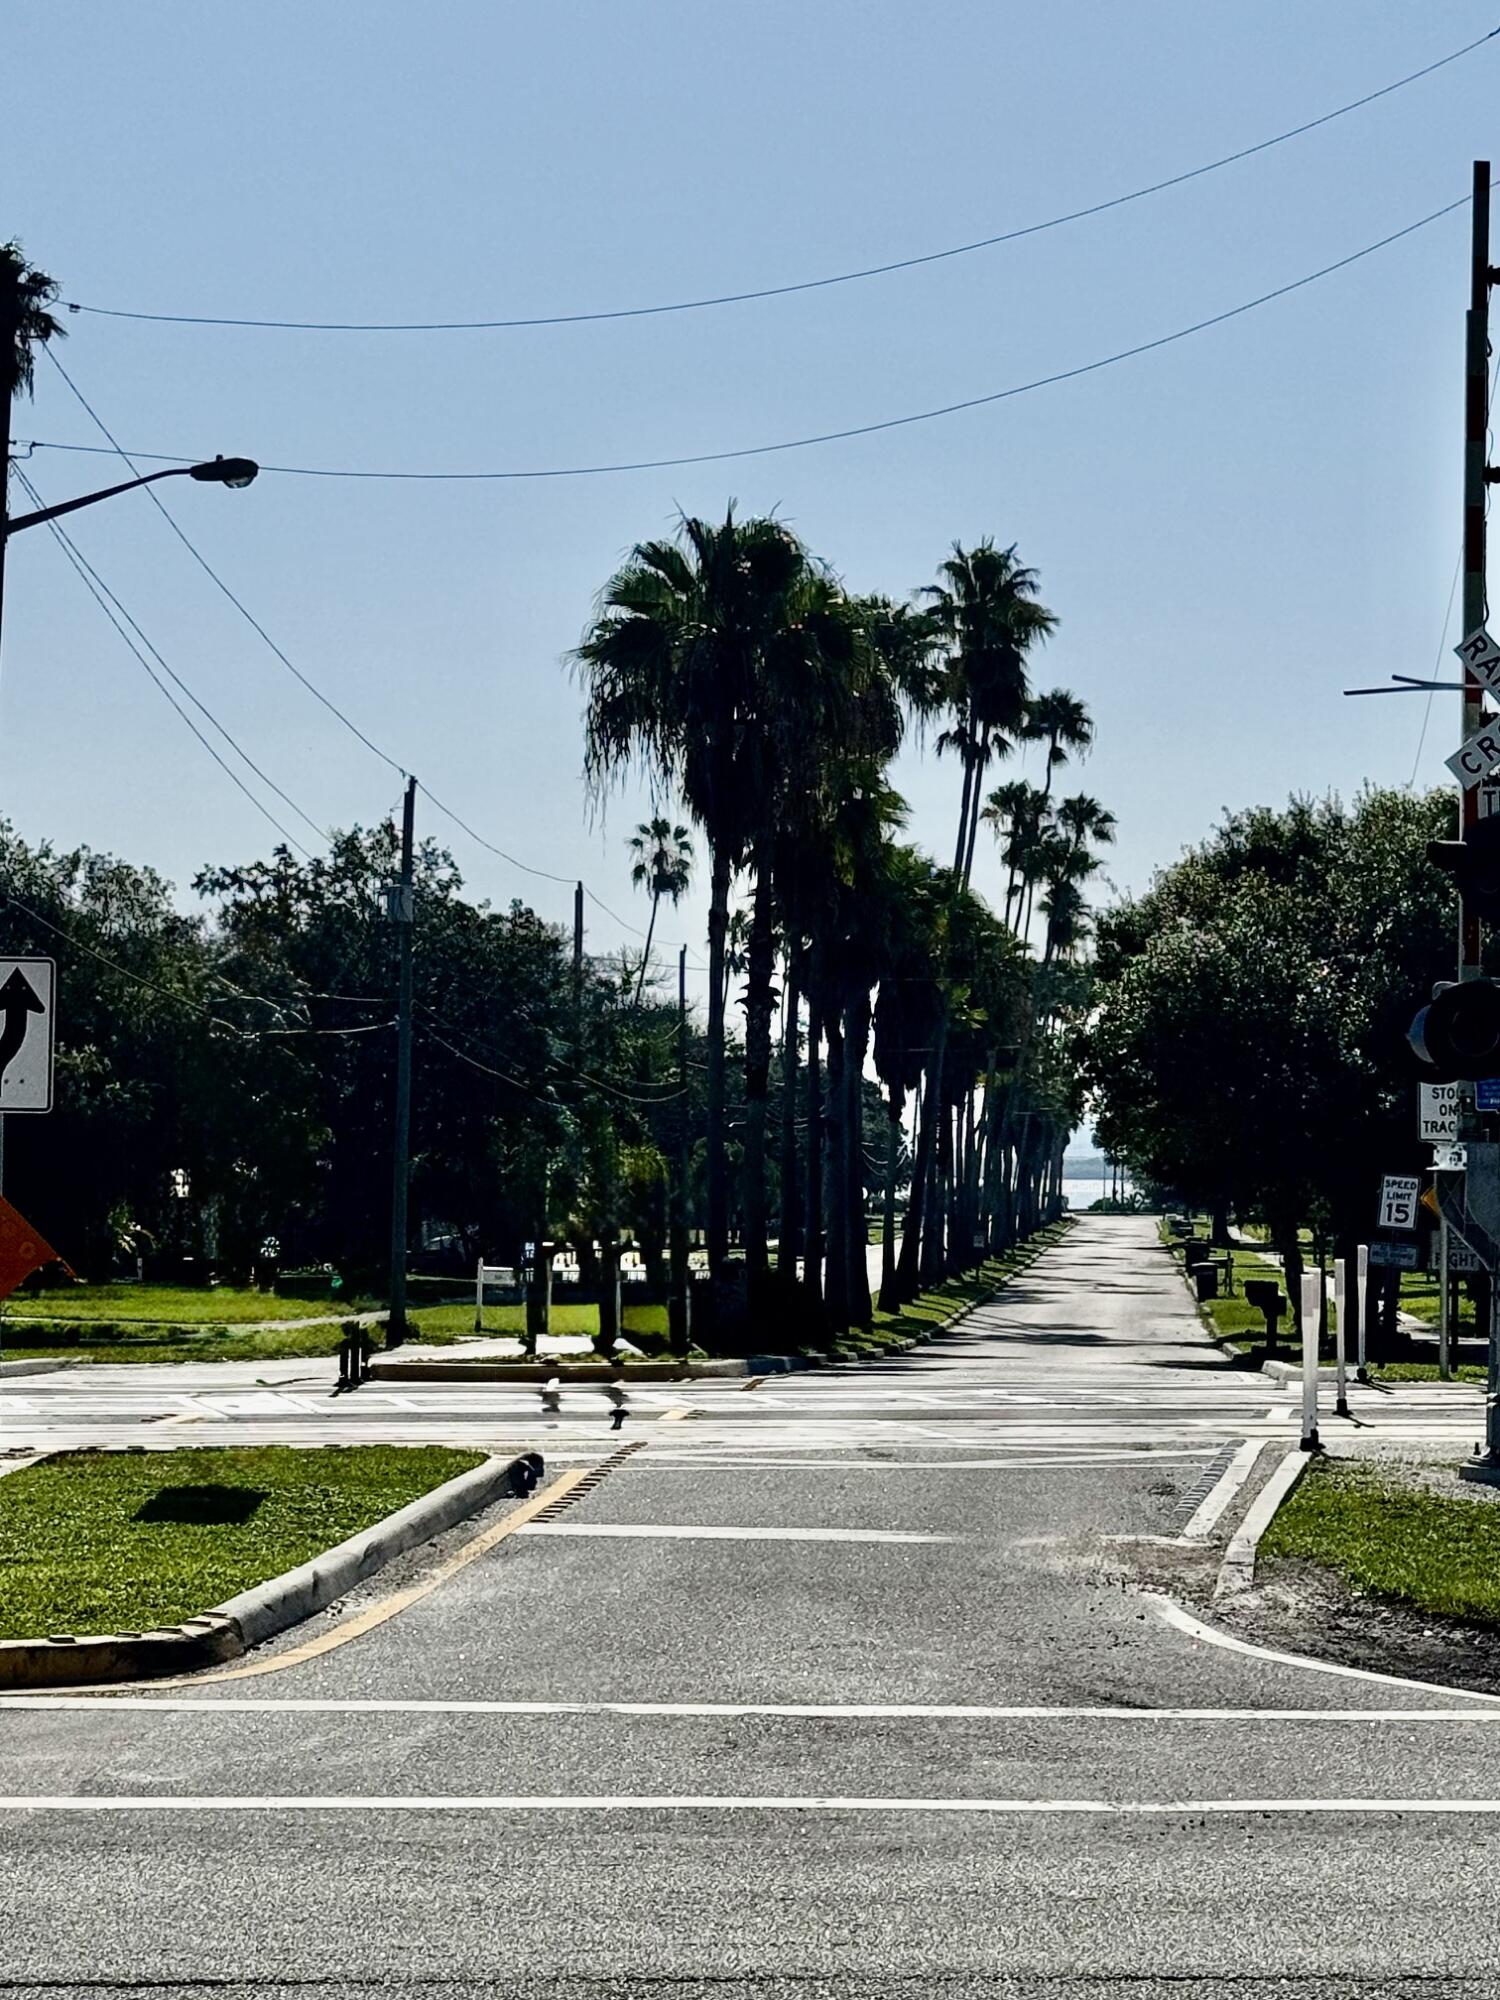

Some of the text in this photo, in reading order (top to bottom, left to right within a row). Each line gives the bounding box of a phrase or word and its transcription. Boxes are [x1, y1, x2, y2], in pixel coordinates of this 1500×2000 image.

[1463, 635, 1500, 694] RAI
[1461, 725, 1500, 774] CR
[1432, 1087, 1455, 1099] STO
[1439, 1104, 1457, 1116] ON
[1423, 1120, 1456, 1133] TRAC
[1385, 1179, 1417, 1190] SPEED
[1386, 1191, 1412, 1201] LIMIT
[1386, 1202, 1410, 1223] 15
[1435, 1252, 1476, 1266] RGHT
